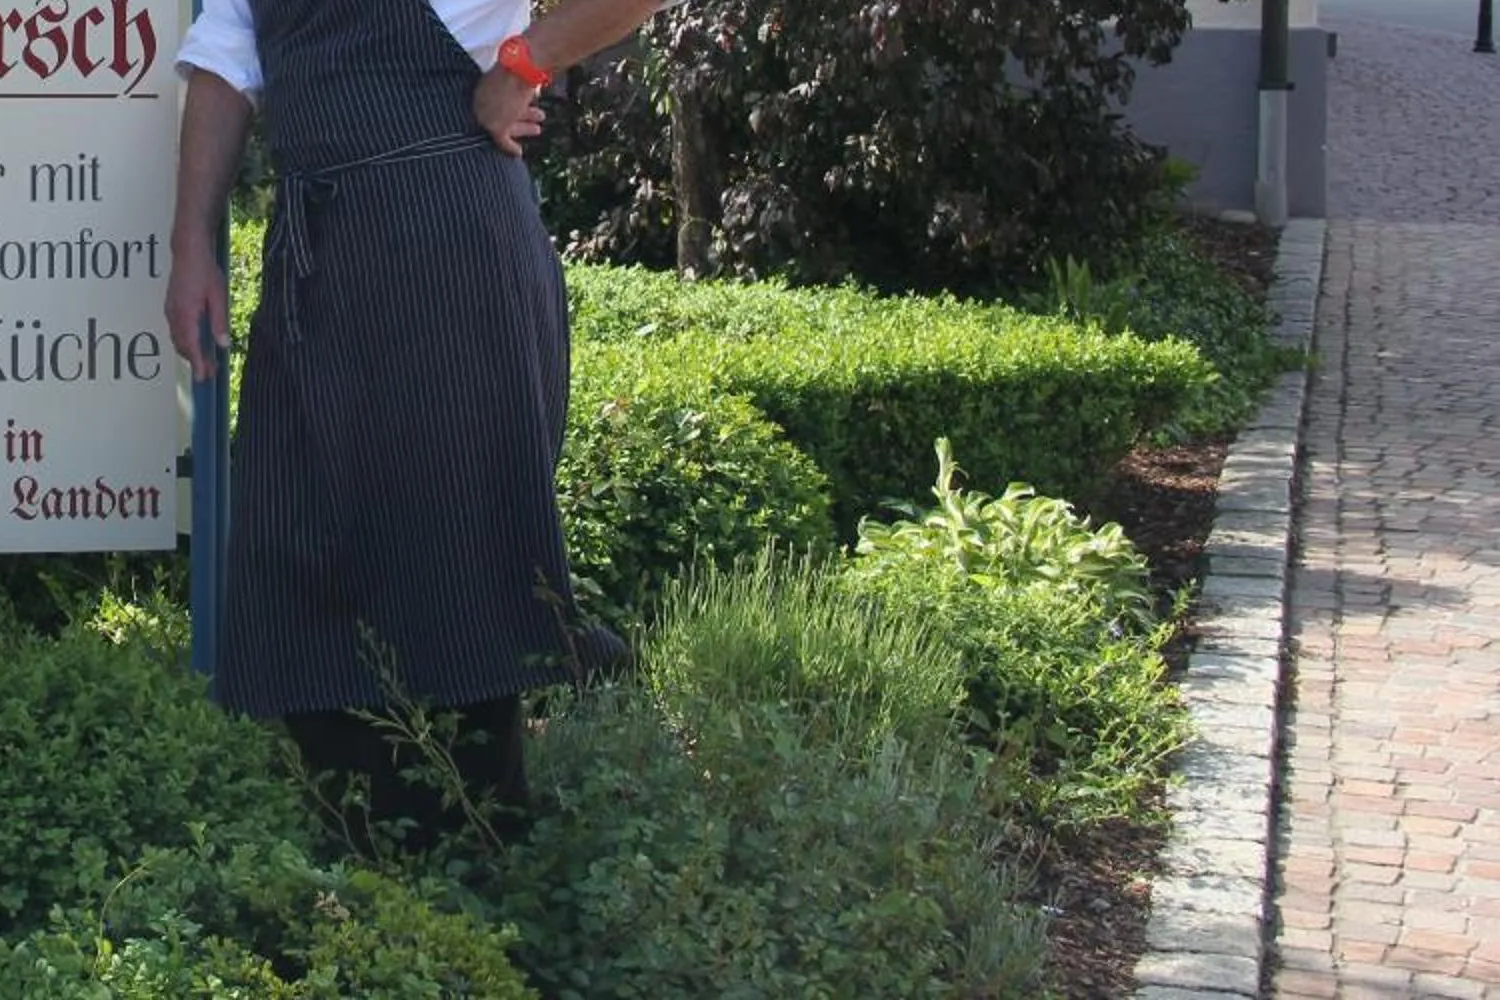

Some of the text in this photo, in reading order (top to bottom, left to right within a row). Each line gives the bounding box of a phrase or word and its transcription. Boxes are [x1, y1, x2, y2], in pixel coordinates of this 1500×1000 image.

[29, 152, 102, 202] mit
[4, 419, 43, 463] in
[10, 475, 161, 520] Landen
